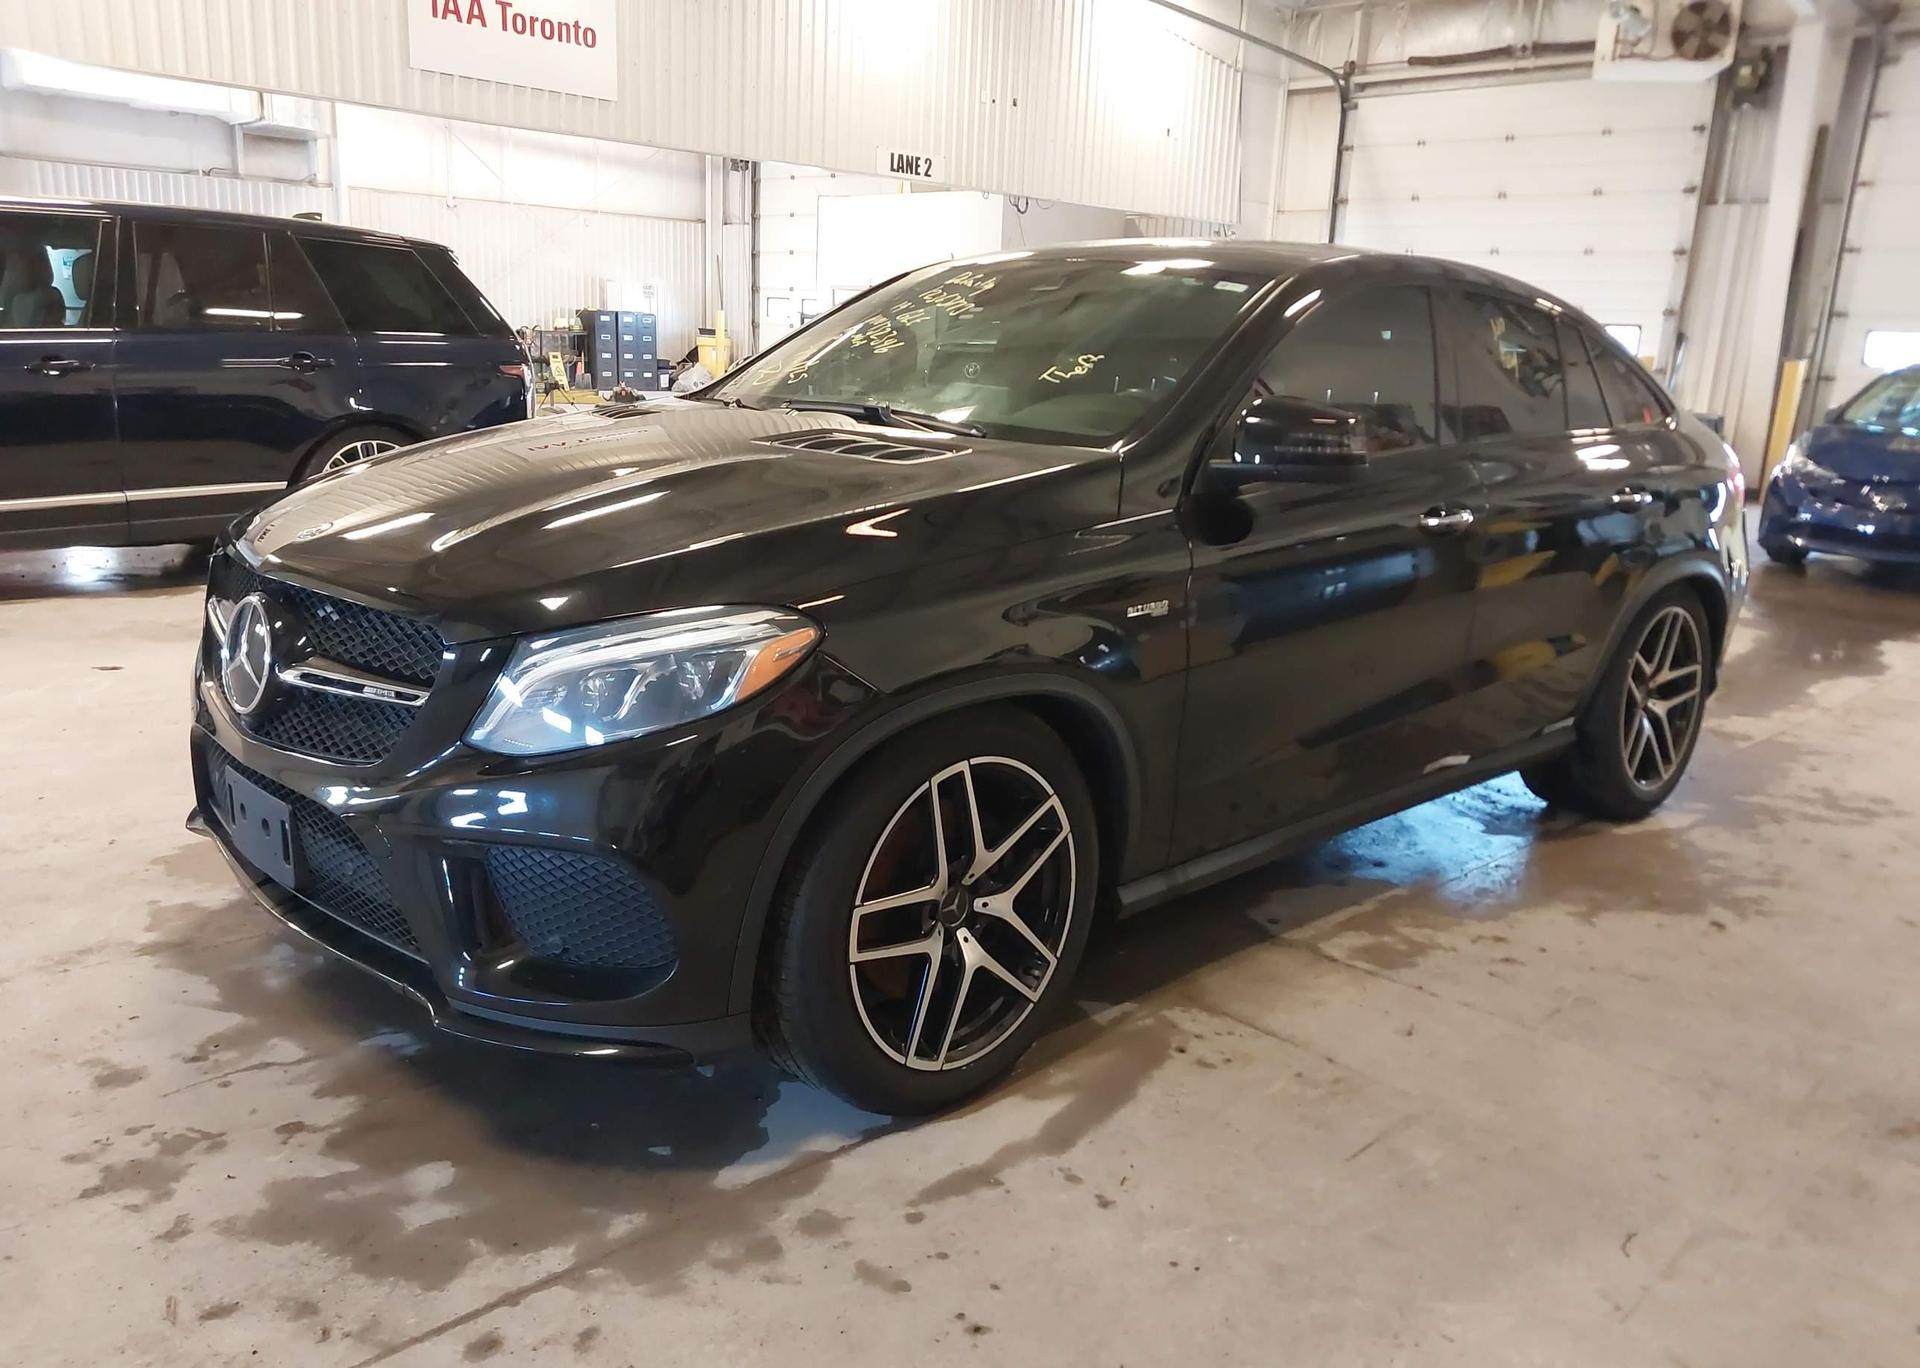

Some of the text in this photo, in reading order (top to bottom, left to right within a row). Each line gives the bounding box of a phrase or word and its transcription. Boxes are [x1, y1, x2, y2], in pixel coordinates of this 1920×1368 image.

[431, 0, 597, 48] IAA Toronto
[890, 152, 932, 178] LANE 2
